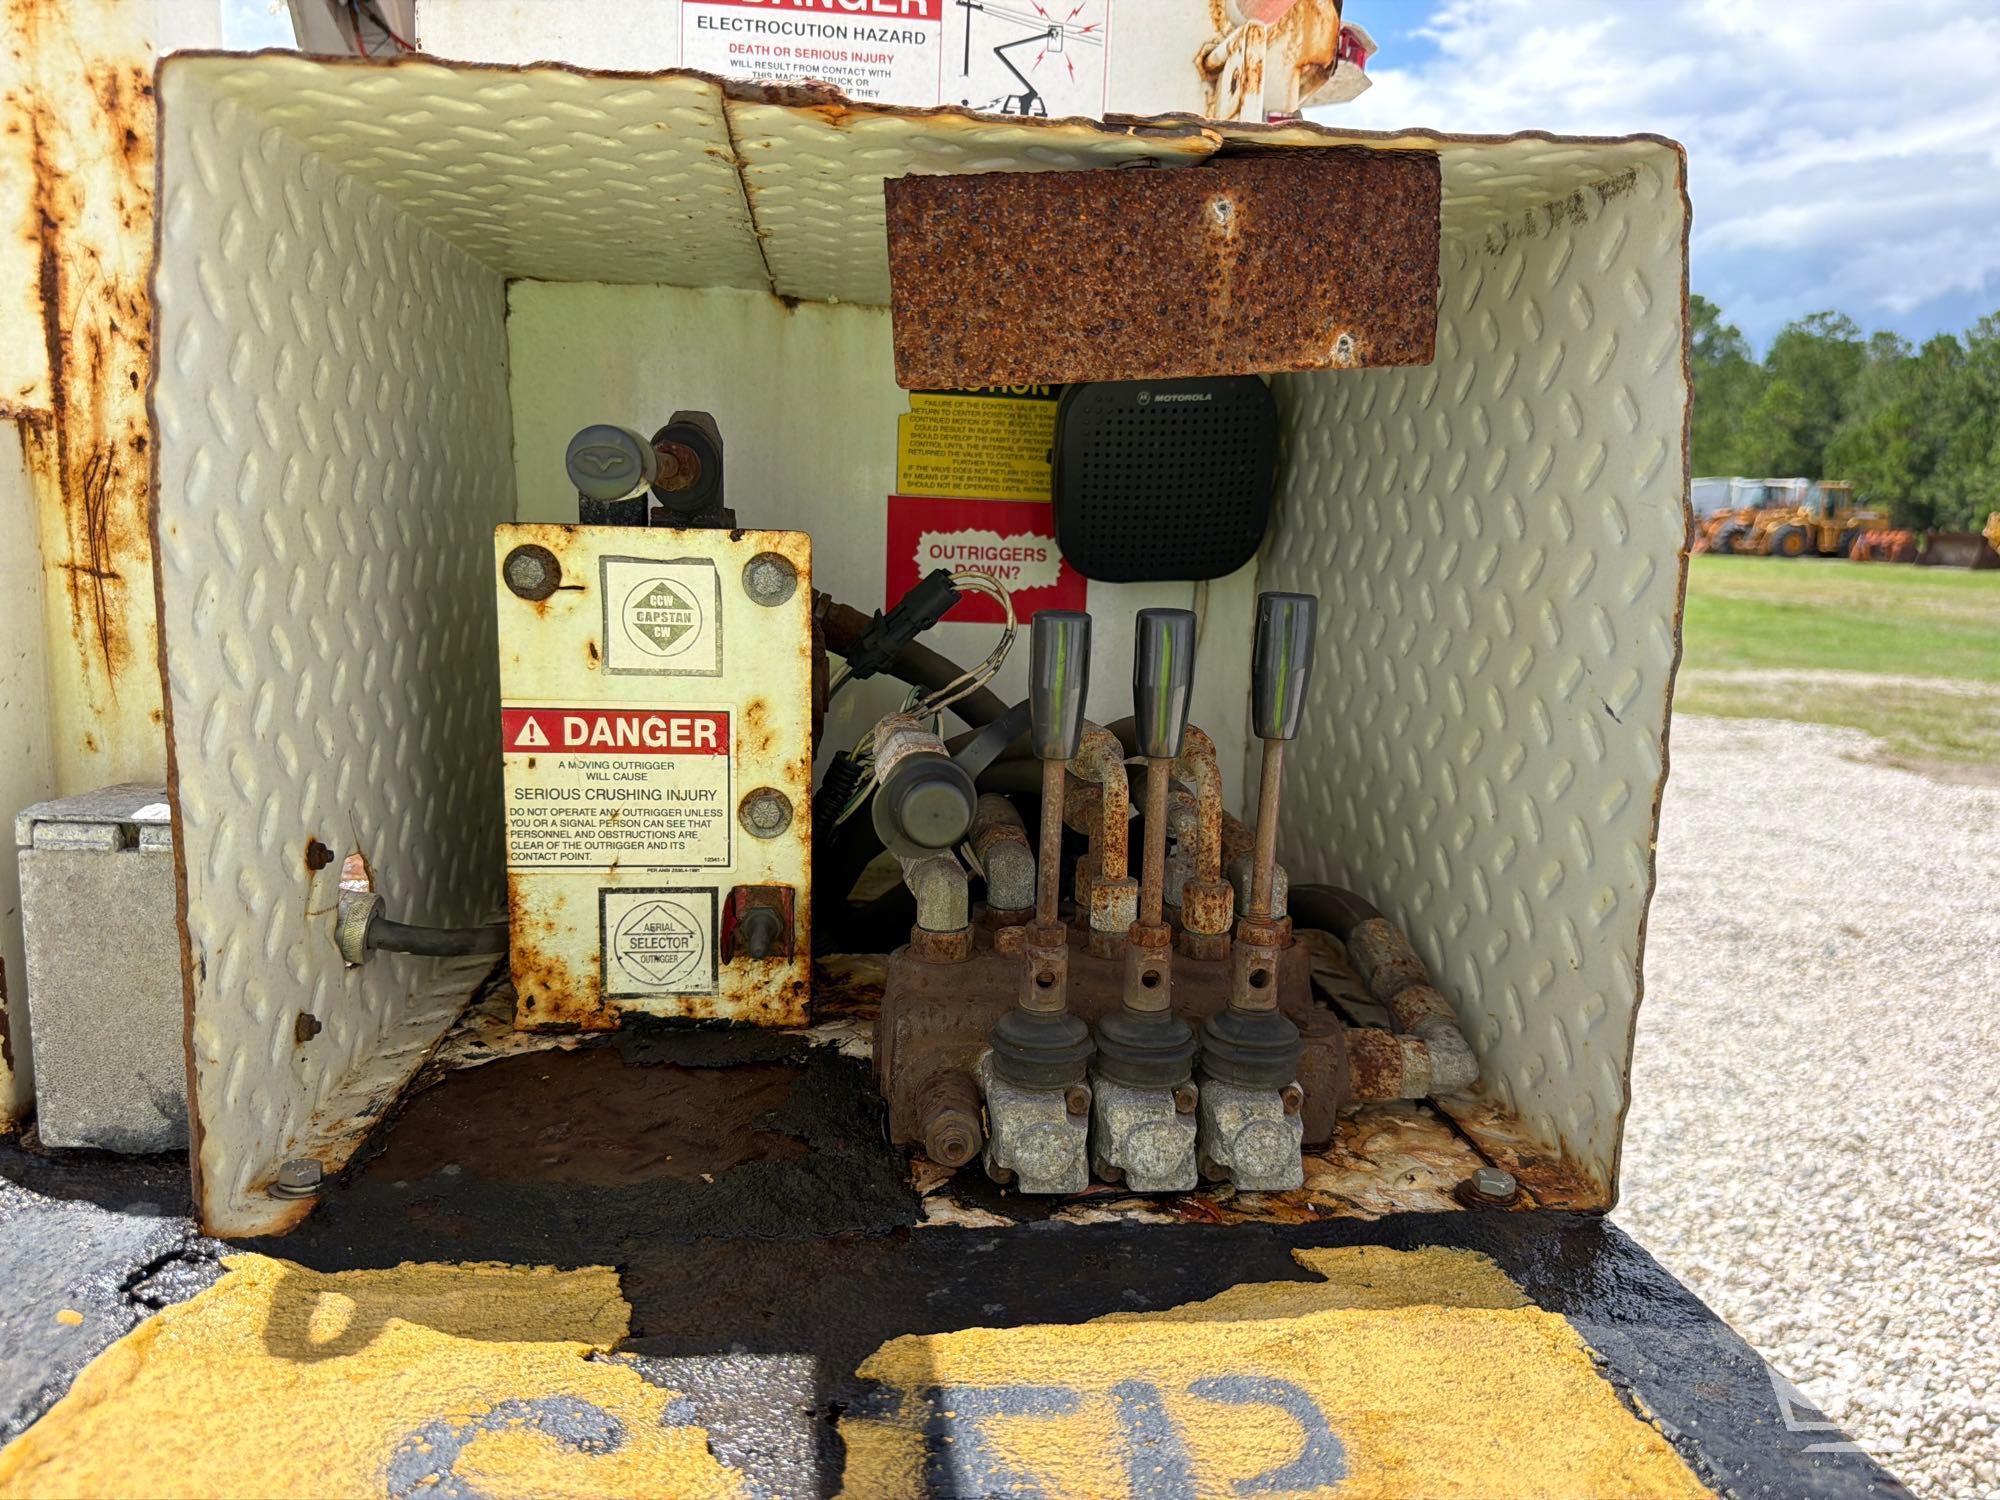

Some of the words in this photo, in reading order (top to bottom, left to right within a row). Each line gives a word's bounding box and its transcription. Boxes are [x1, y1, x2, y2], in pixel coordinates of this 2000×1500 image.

[698, 16, 848, 39] ELECTROCUTION
[853, 28, 926, 45] HAZARD
[729, 43, 770, 56] DEATH
[773, 47, 790, 57] OR
[794, 48, 848, 61] SERIOUS
[851, 52, 894, 64] INJURY
[730, 59, 752, 68] WILL
[755, 61, 791, 71] RESULT
[794, 63, 819, 73] FROM
[822, 66, 866, 76] CONTACT
[869, 69, 891, 78] WITH
[856, 78, 869, 86] OR
[856, 89, 880, 98] THEY
[1155, 393, 1212, 402] MOTOROLA
[929, 544, 1047, 562] OUTRIGGERS
[650, 595, 673, 606] CCW
[636, 611, 692, 623] CAPSTAN
[654, 626, 671, 637] CW
[564, 716, 717, 748] DANGER
[559, 761, 566, 769] A
[568, 761, 610, 769] MOVING
[612, 761, 675, 770] OUTRIGGER
[586, 772, 610, 780] WILL
[613, 773, 648, 781] CAUSE
[514, 788, 581, 800] SERIOUS
[585, 788, 662, 801] CRUSHING
[666, 789, 717, 801] INJURY
[510, 808, 524, 816] DO
[527, 808, 548, 816] NOT
[550, 808, 597, 816] OPERATE
[600, 808, 620, 817] ANY
[622, 808, 682, 817] OUTRIGGER
[684, 809, 723, 817] UNLESS
[510, 819, 531, 827] YOU
[533, 819, 548, 827] OR
[560, 819, 597, 828] SIGNAL
[599, 820, 641, 828] PERSON
[643, 820, 664, 828] CAN
[666, 820, 686, 828] SEE
[688, 820, 712, 828] THAT
[510, 830, 572, 838] PERSONNEL
[574, 830, 595, 838] AND
[598, 830, 676, 839] OBSTRUCTIONS
[678, 831, 698, 839] ARE
[511, 841, 544, 850] CLEAR
[546, 841, 560, 849] OF
[563, 841, 582, 849] THE
[584, 841, 644, 850] OUTRIGGER
[647, 841, 668, 849] AND
[511, 852, 557, 861] CONTACT
[560, 852, 592, 861] POINT.
[644, 923, 675, 932] AERIAL
[630, 937, 689, 949] SELECTOR
